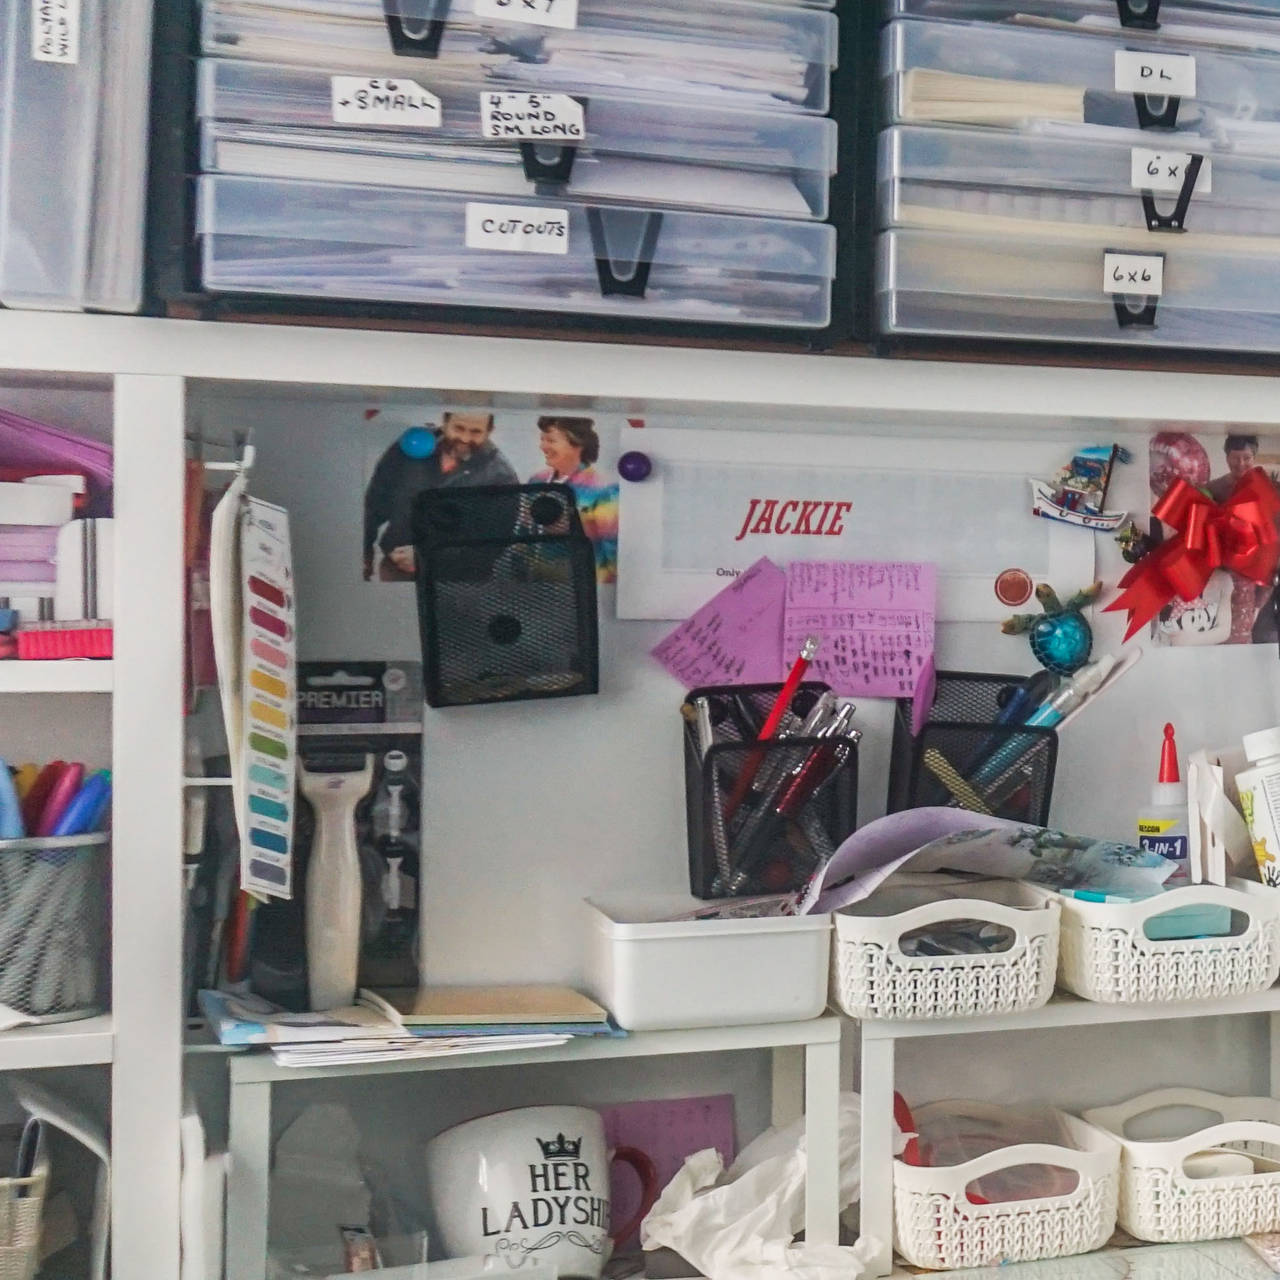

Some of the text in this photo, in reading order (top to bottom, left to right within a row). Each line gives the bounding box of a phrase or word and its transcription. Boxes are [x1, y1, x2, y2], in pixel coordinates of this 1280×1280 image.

[39, 0, 53, 55] POLYA
[355, 89, 436, 112] SMALL
[490, 110, 556, 122] ROUND
[491, 122, 581, 136] SM LONG
[735, 498, 852, 541] JACKIE
[716, 567, 741, 578] Only
[298, 681, 383, 709] PREMIER
[528, 1162, 591, 1193] HER
